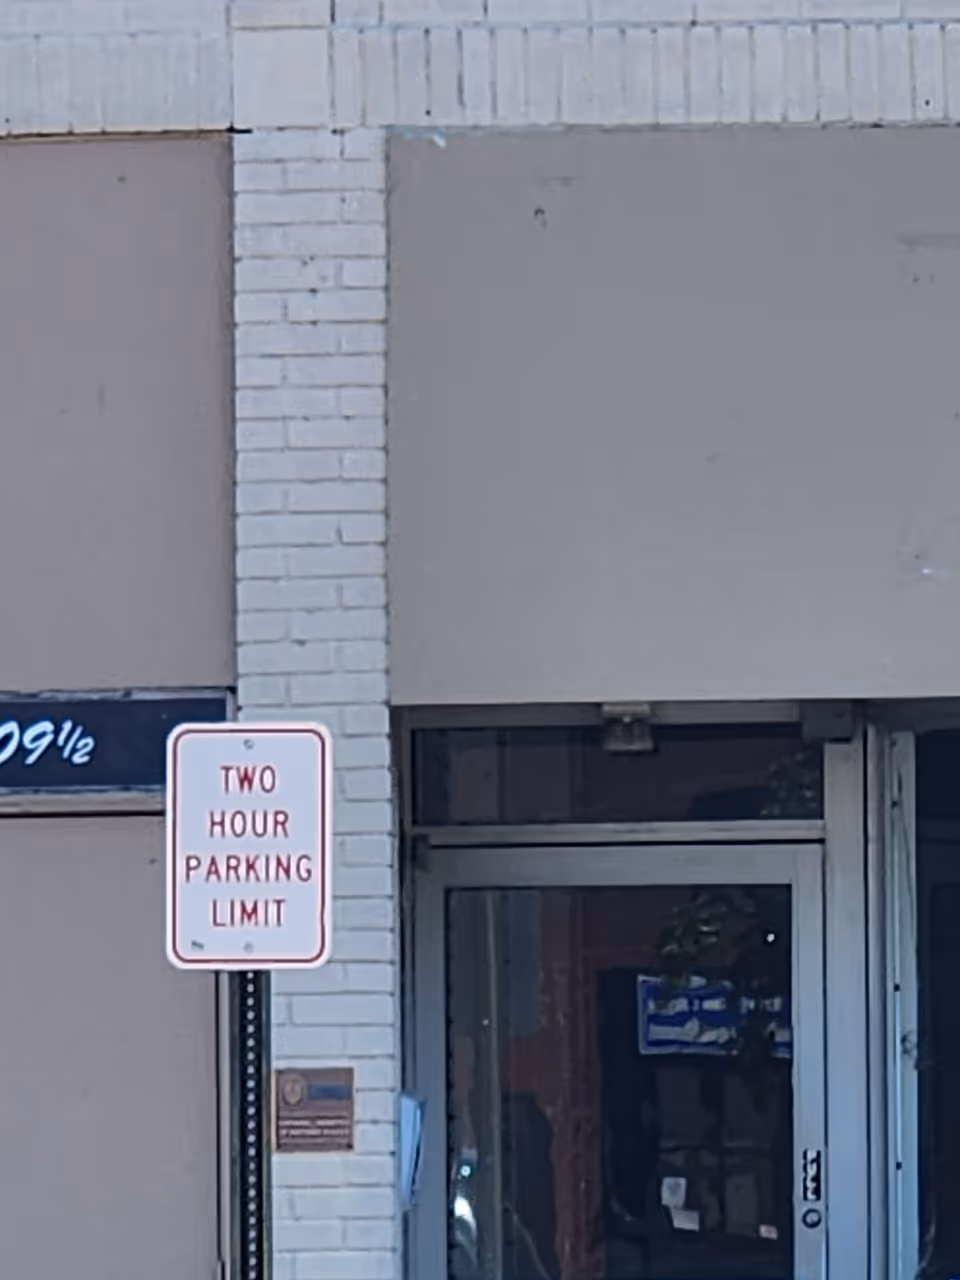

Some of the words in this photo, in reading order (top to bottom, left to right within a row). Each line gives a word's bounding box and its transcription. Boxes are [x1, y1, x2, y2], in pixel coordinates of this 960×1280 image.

[220, 765, 277, 793] TWO
[209, 810, 289, 838] HOUR
[185, 855, 312, 883] PARKING
[212, 899, 286, 927] LIMIT
